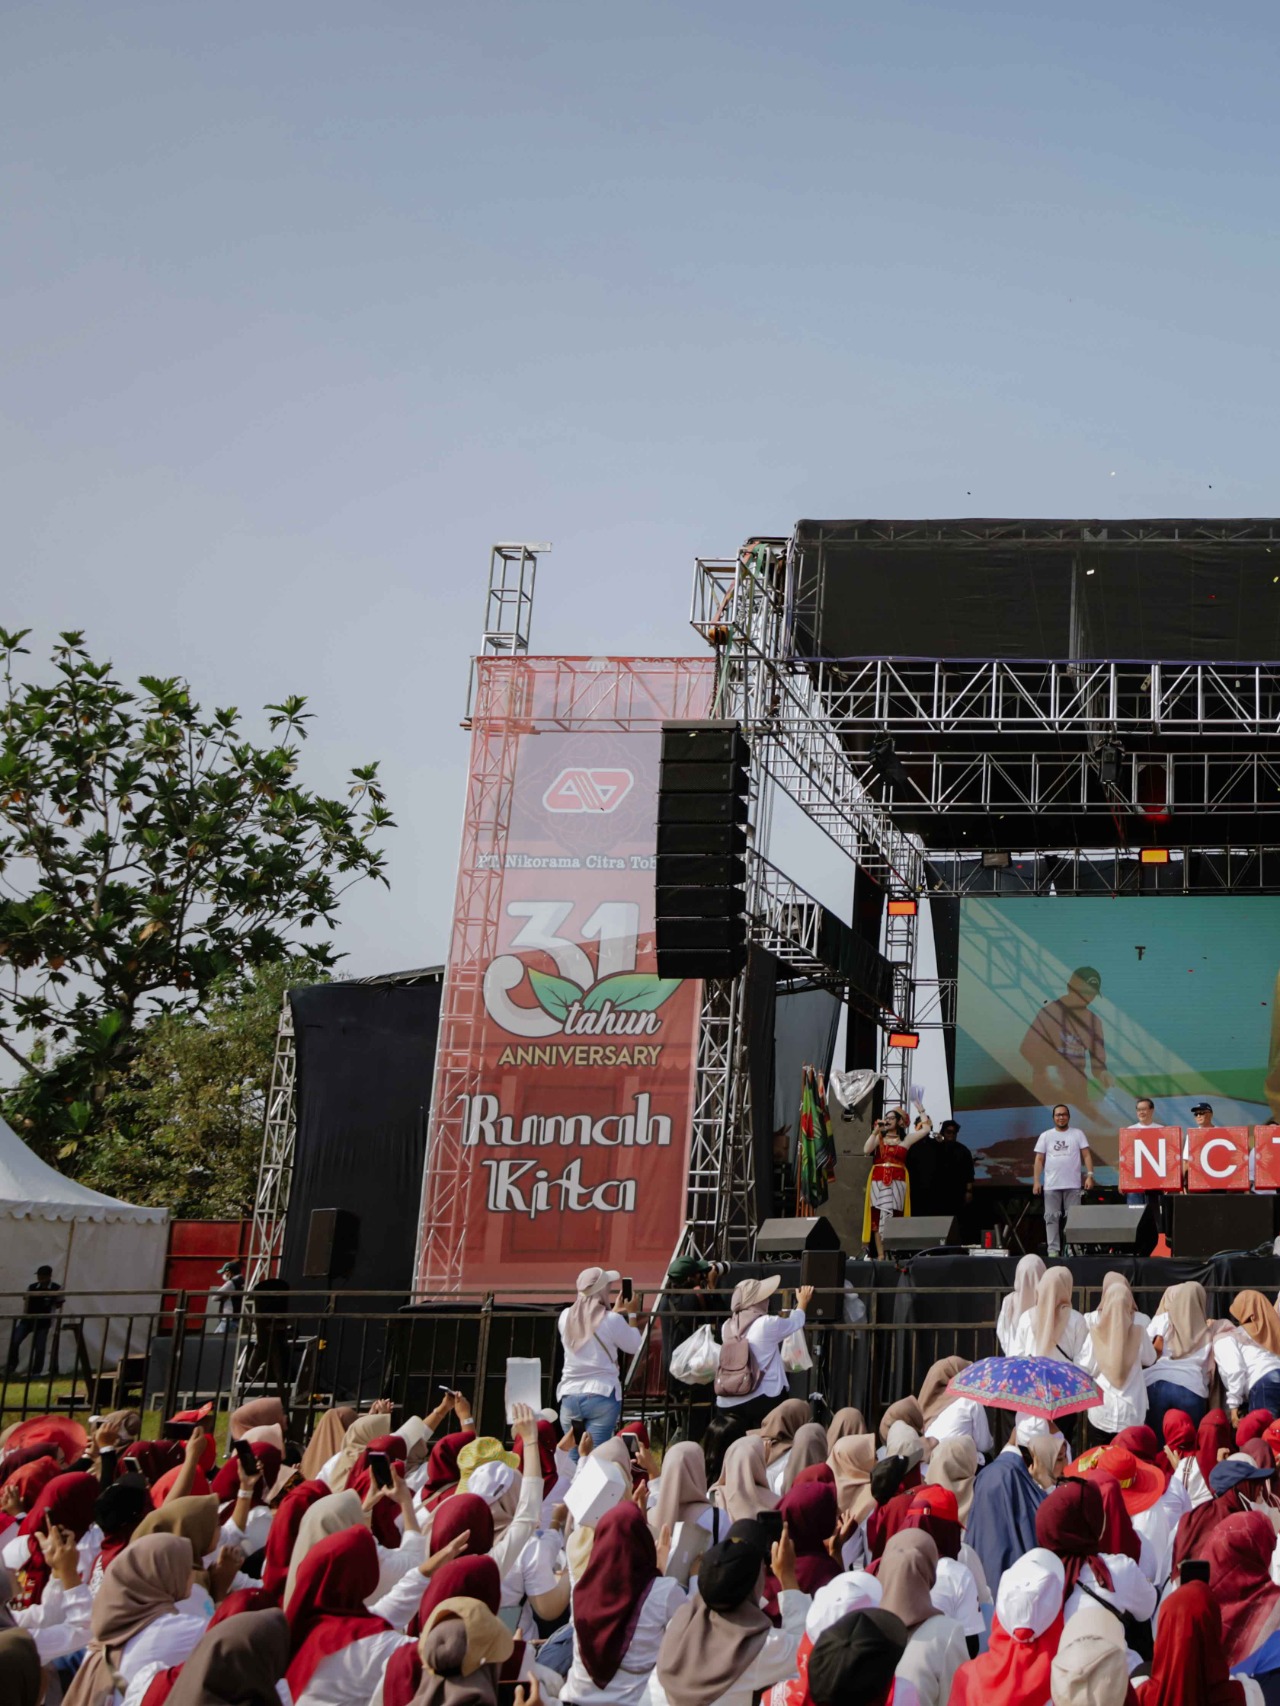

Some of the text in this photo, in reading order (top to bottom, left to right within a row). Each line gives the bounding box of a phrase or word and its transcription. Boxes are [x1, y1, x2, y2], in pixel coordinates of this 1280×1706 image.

[505, 854, 581, 869] Nikorama
[585, 855, 626, 869] Citra
[562, 1001, 663, 1036] tahun
[498, 1045, 663, 1067] ANNIVERSARY
[456, 1092, 672, 1146] Rumah
[481, 1157, 637, 1219] Kita
